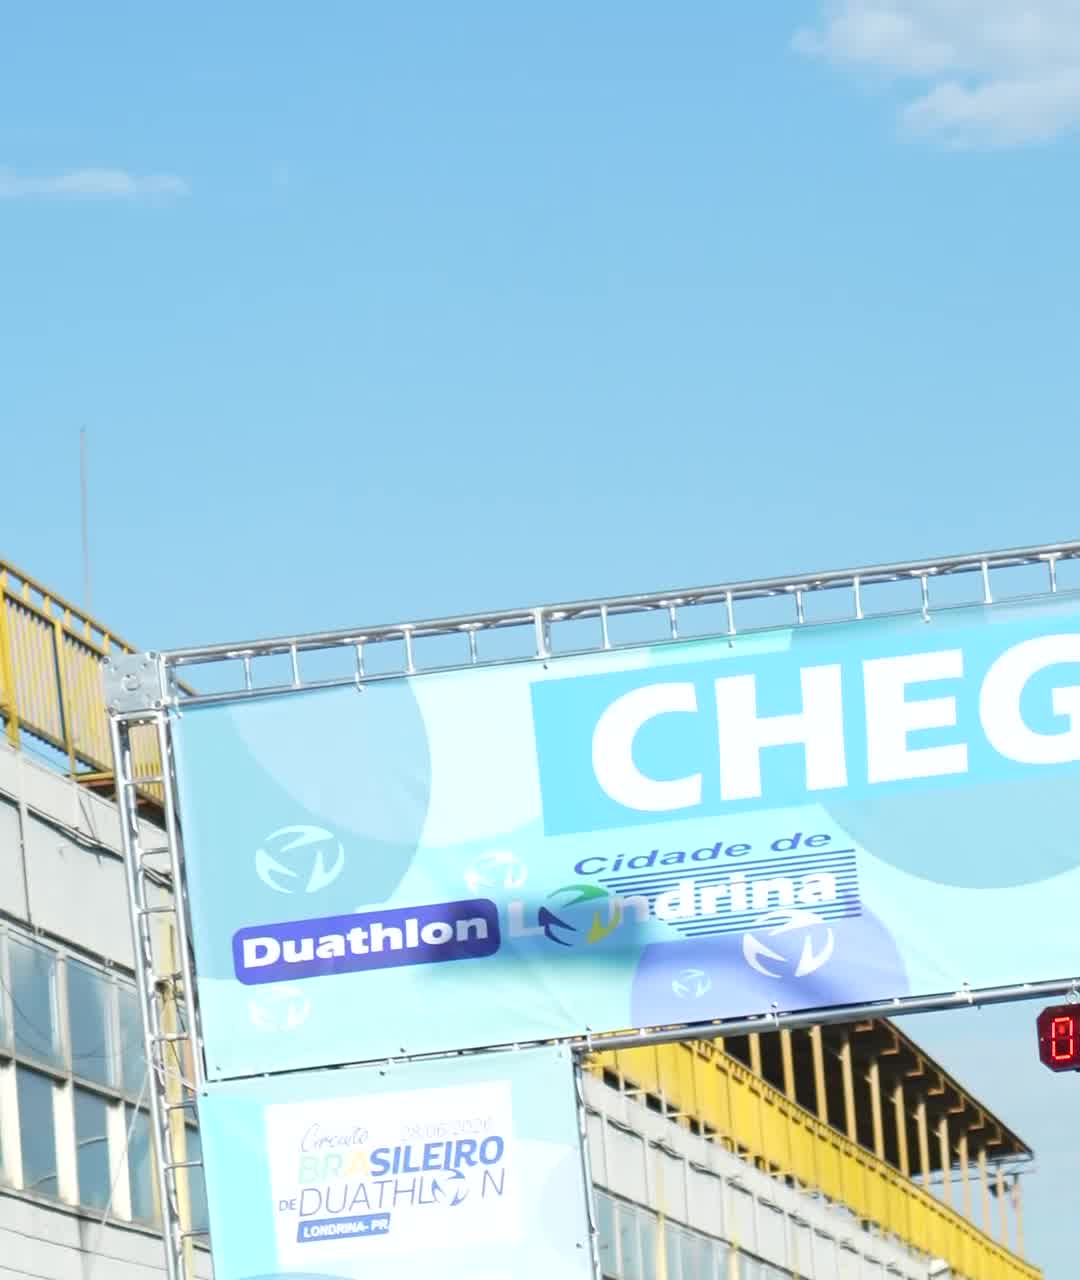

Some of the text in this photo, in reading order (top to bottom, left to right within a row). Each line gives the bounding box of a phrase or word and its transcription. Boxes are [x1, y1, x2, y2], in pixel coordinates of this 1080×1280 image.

[573, 830, 832, 877] Cidade de
[242, 912, 488, 968] Duathlon
[298, 1135, 505, 1184] BRASILEIRO
[279, 1198, 297, 1212] DE
